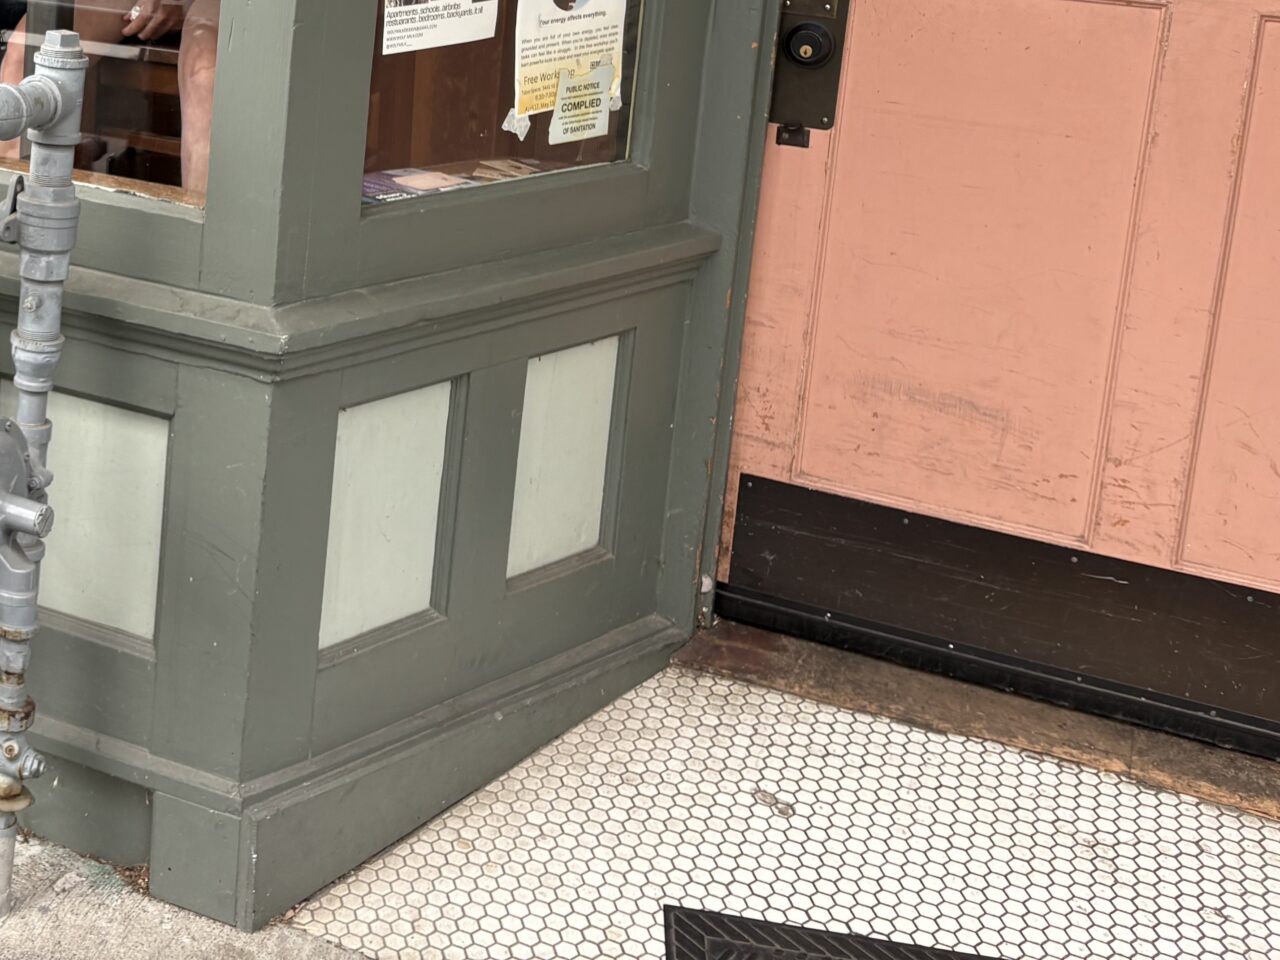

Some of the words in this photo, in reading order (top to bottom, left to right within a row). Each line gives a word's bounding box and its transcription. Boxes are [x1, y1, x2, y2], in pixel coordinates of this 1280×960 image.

[550, 17, 566, 25] energy
[524, 75, 538, 86] Free
[566, 84, 582, 94] PUBLIC
[583, 82, 600, 90] NOTICE
[561, 98, 602, 113] COMPLIED
[570, 123, 596, 134] SANITATION
